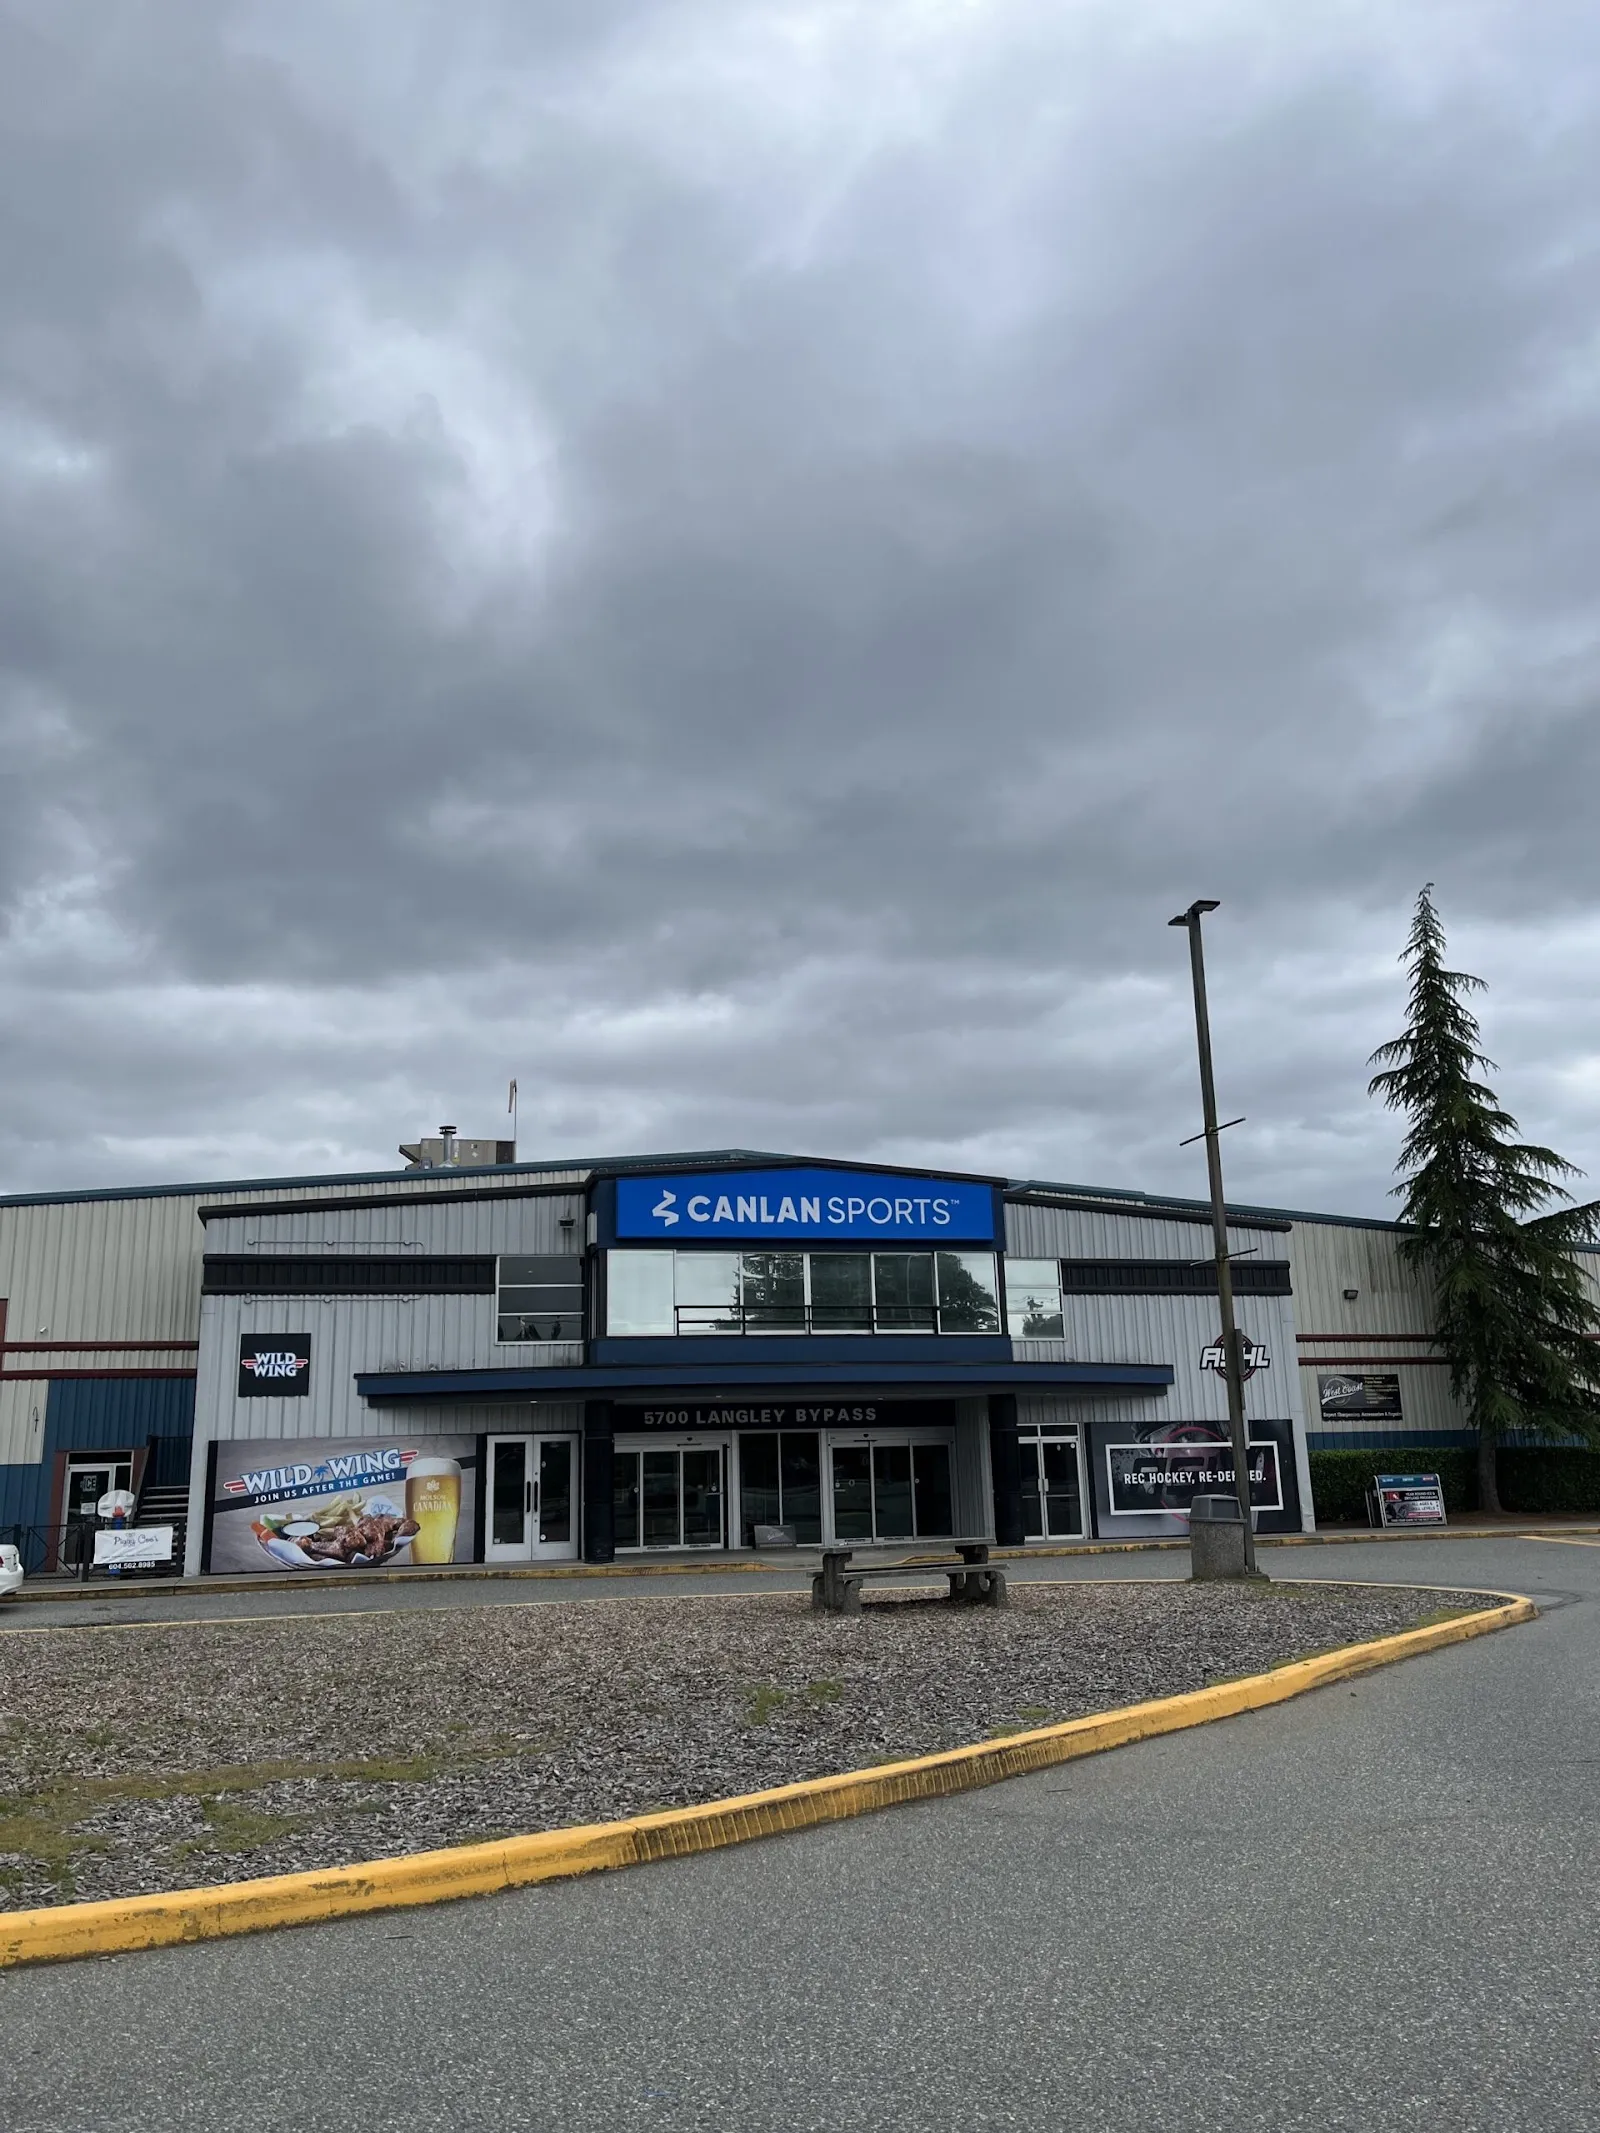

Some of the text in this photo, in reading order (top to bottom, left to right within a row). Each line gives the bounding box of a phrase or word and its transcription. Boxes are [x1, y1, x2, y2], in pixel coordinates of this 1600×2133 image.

[687, 1196, 820, 1224] CANLAN
[254, 1352, 296, 1365] WILD
[1200, 1345, 1270, 1369] AHL
[253, 1364, 297, 1377] WING
[1323, 1382, 1363, 1398] West Coast
[644, 1407, 877, 1425] 5700 LANGLEY BYPASS
[241, 1447, 401, 1494] WILD WING
[1124, 1473, 1145, 1484] REC
[1149, 1471, 1195, 1485] HOCKEY,
[254, 1473, 395, 1503] JOIN US AFTER THE GAME!
[413, 1501, 453, 1512] CANADIAN
